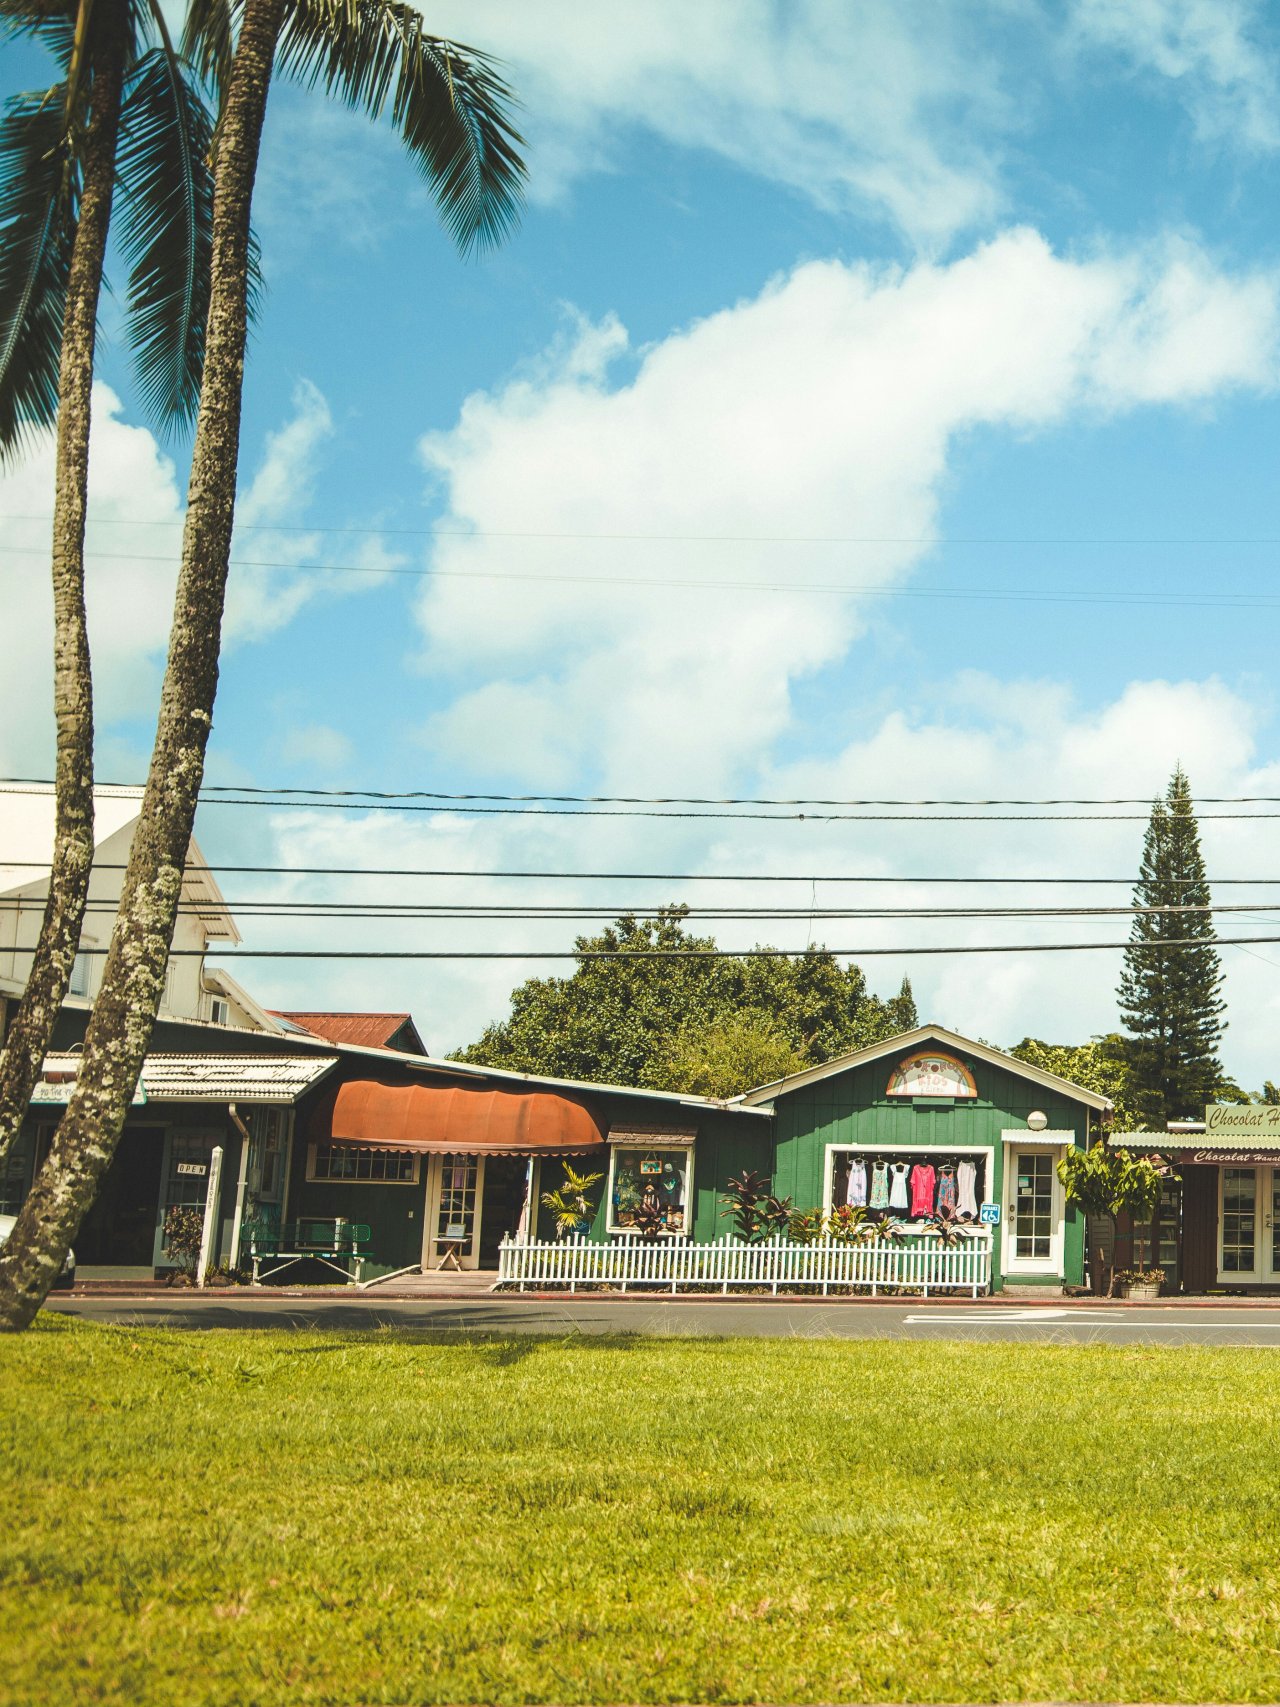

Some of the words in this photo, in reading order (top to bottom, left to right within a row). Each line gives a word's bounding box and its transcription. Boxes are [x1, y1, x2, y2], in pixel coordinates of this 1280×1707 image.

[1209, 1108, 1264, 1129] Chocolat
[1193, 1150, 1250, 1162] Chocolat
[180, 1165, 204, 1174] OPEN
